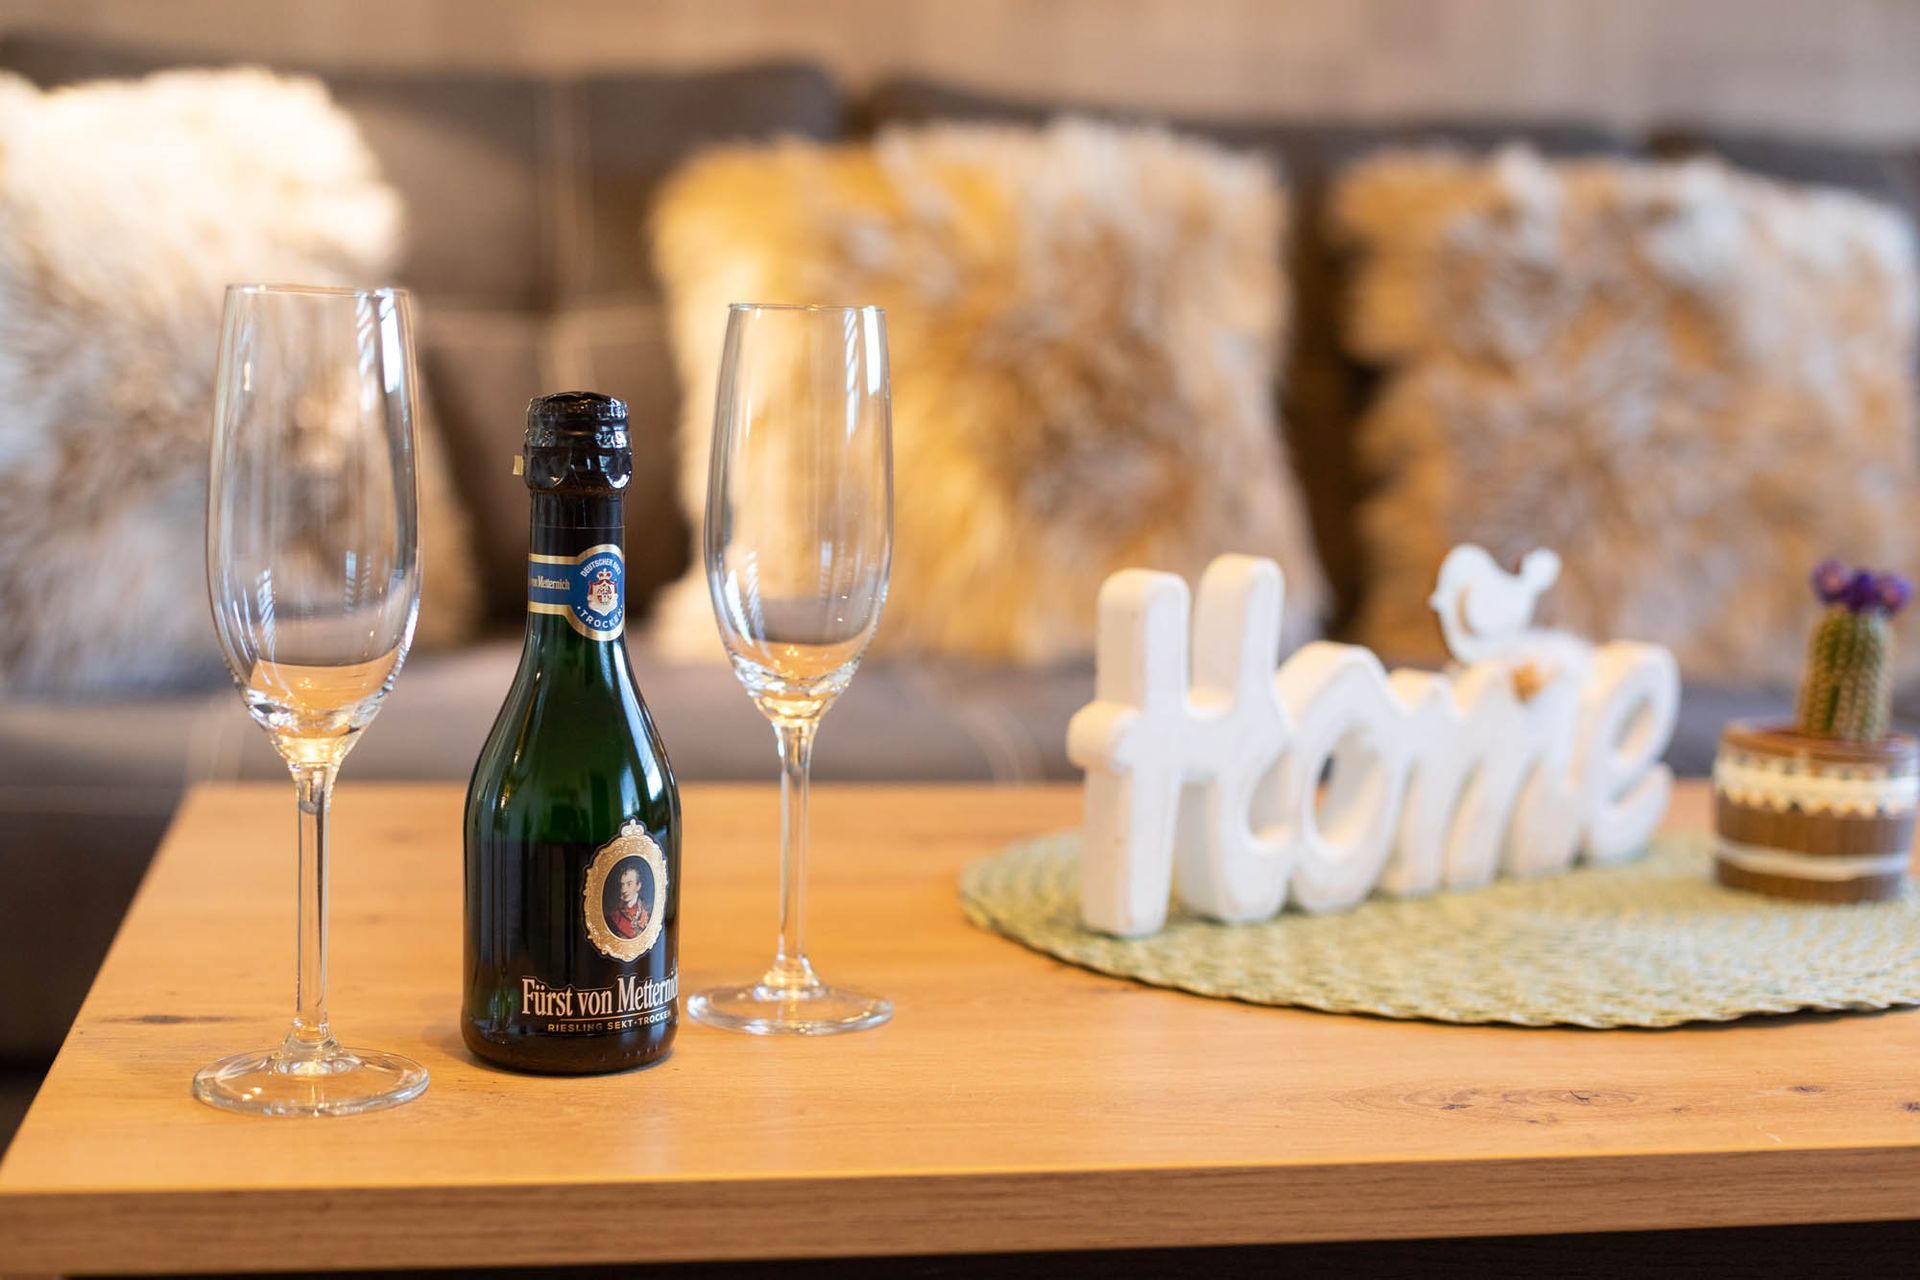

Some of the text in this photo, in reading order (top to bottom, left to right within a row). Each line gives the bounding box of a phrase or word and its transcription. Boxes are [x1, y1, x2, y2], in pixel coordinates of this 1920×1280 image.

[580, 558, 612, 577] DEUTSCHER
[579, 608, 622, 628] TROCKEN
[1067, 552, 1681, 938] Home
[522, 978, 573, 1017] Fürst
[577, 990, 613, 1016] von
[547, 1022, 603, 1033] RIESLING
